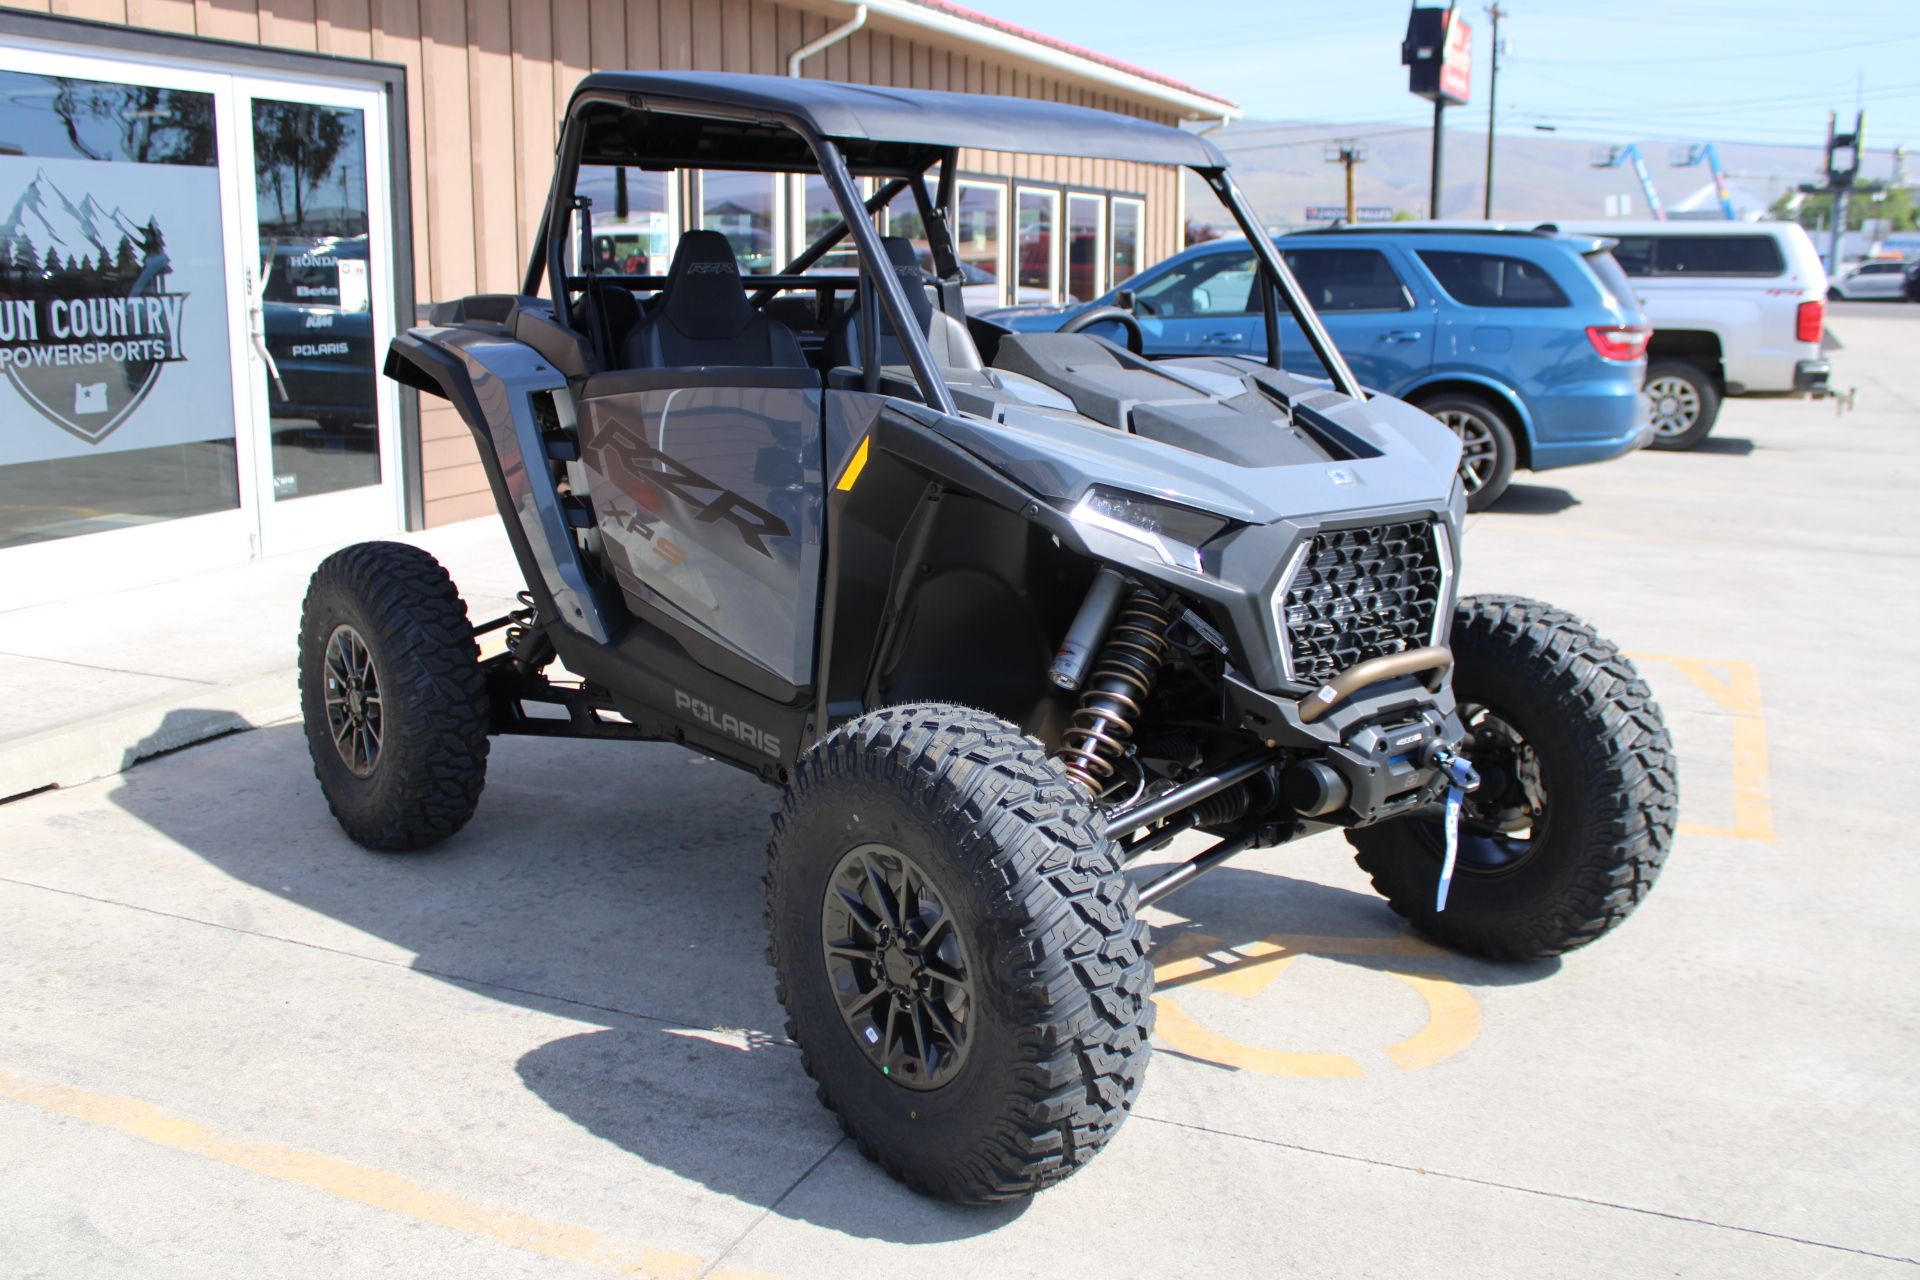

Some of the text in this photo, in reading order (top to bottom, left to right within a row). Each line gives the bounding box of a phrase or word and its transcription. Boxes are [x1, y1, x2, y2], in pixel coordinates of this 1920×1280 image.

[291, 256, 338, 266] HONDA
[296, 286, 338, 296] Beta
[51, 296, 182, 358] COUNTRY
[0, 340, 165, 368] POWERSPORTS
[292, 343, 348, 356] POLARIS
[587, 416, 792, 560] RZR
[675, 689, 780, 758] POLARIS
